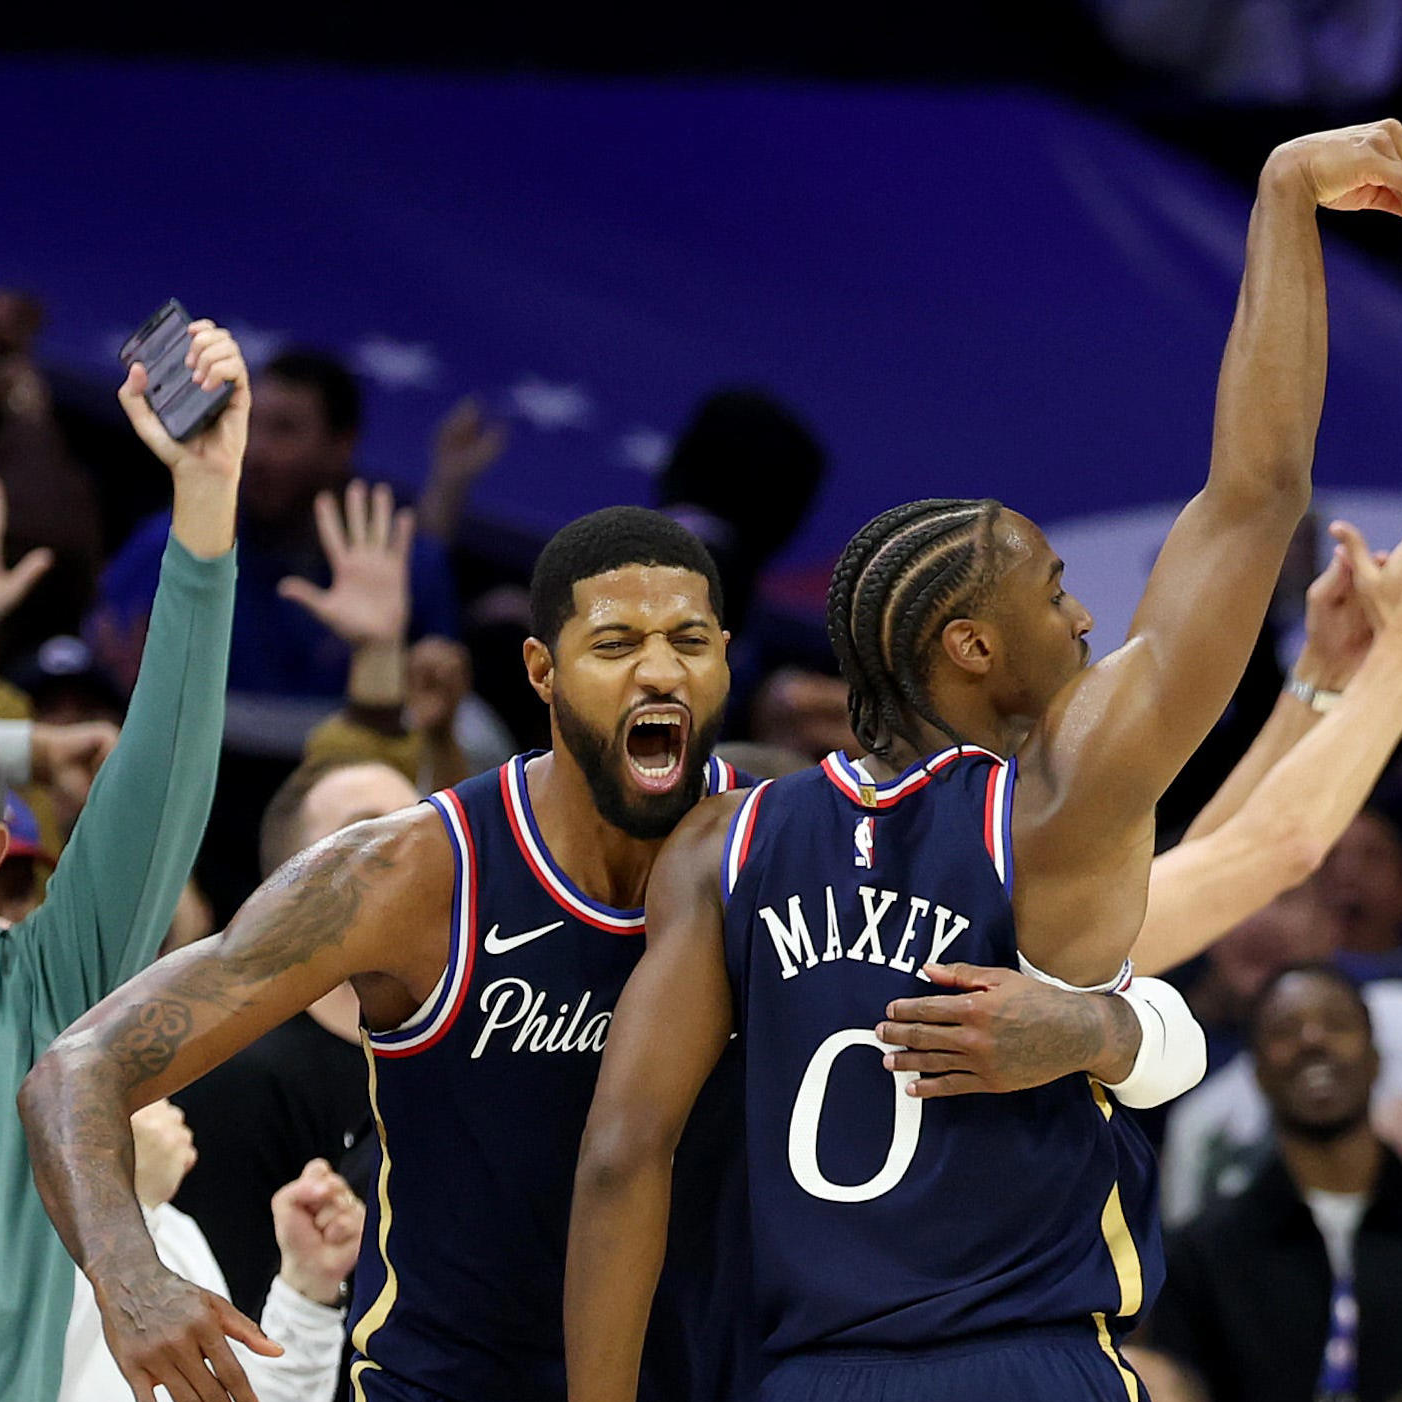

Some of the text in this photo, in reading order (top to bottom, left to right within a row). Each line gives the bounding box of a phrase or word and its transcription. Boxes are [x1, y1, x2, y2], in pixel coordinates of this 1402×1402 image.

[758, 885, 970, 984] MAXEY
[471, 977, 613, 1060] Phila
[788, 1028, 923, 1203] 0
